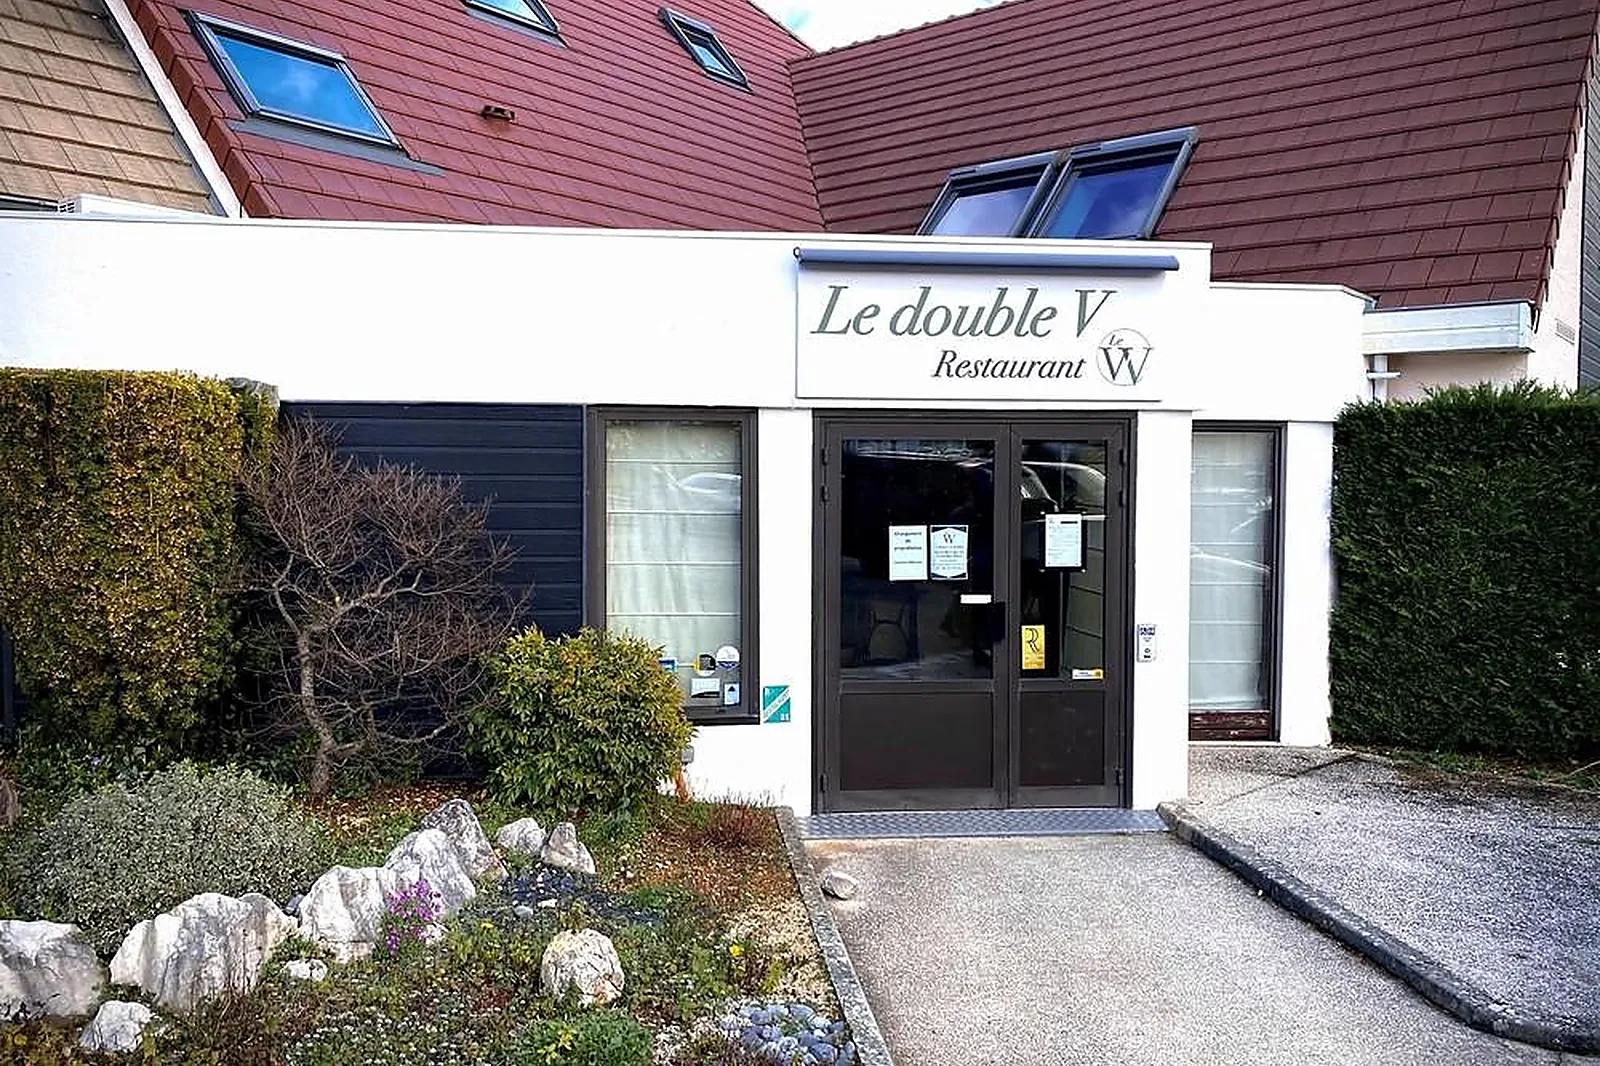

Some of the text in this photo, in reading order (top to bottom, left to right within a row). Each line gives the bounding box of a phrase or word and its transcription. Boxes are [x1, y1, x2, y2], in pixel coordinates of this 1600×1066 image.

[810, 285, 1117, 338] Le double V
[931, 349, 1087, 378] Restaurant
